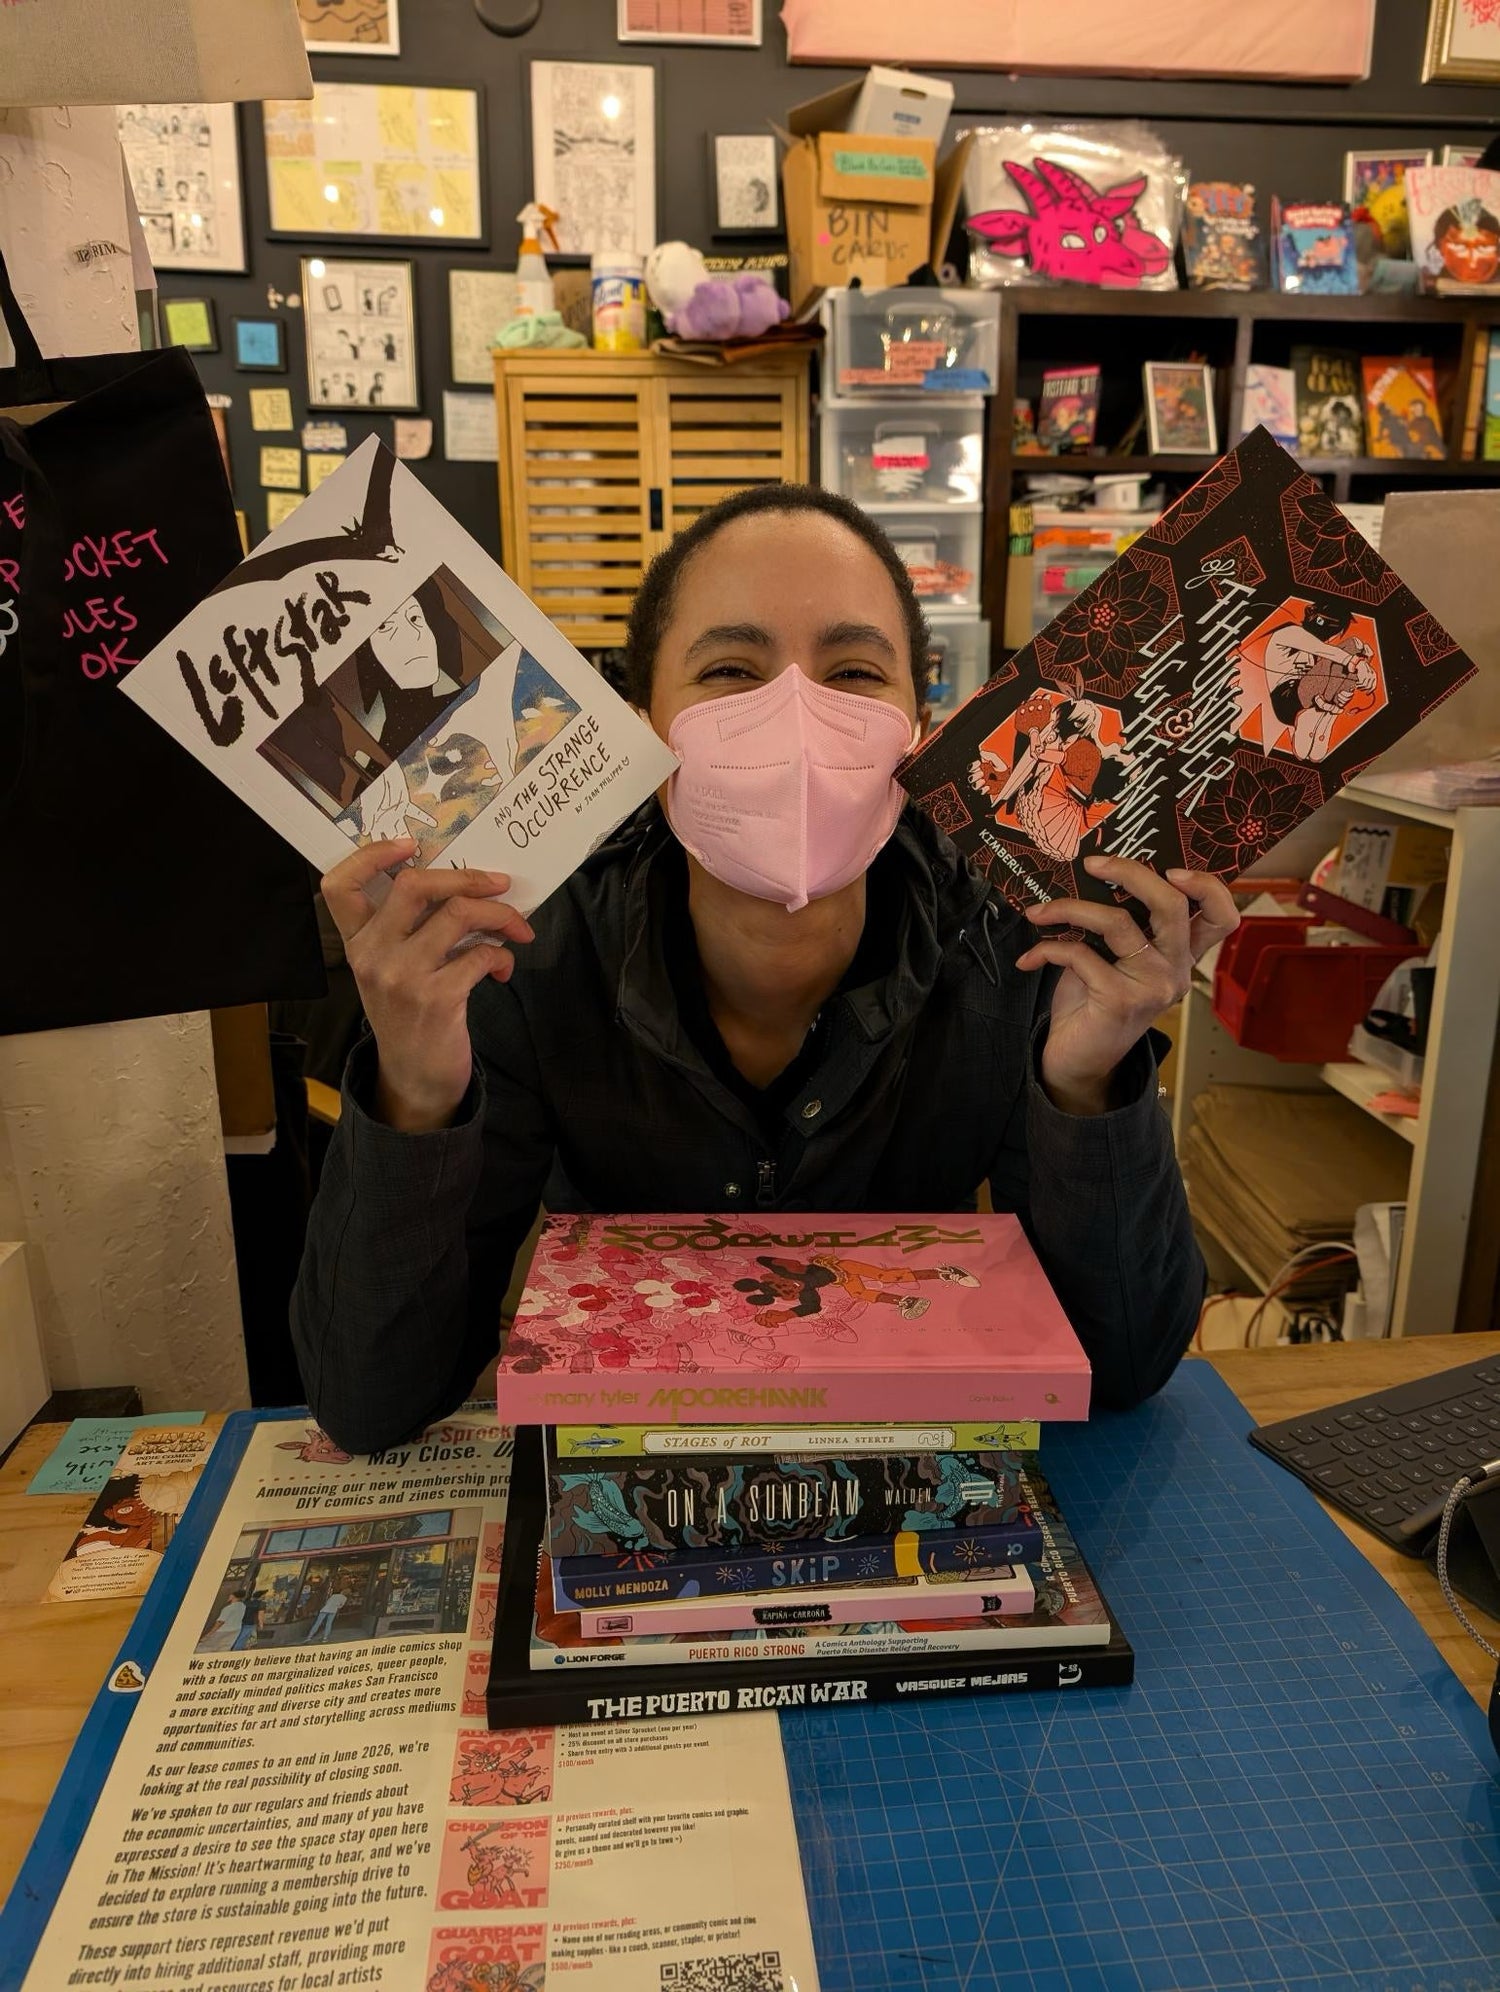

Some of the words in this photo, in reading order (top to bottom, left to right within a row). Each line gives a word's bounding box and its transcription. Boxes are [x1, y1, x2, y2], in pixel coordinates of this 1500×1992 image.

[81, 638, 140, 680] OK
[1175, 578, 1257, 818] THUNDER
[1164, 708, 1194, 738] &
[494, 806, 513, 830] AND
[512, 780, 539, 811] THE
[538, 715, 600, 791] STRANGE
[507, 741, 611, 849] OCCURRENCE
[574, 804, 584, 815] BY
[598, 764, 624, 791] PHILIPPE
[978, 828, 1025, 877] KIMBERLY
[1023, 874, 1052, 904] WANG
[544, 1390, 594, 1408] mary
[600, 1390, 641, 1409] tyler
[662, 1435, 718, 1449] STAGES
[723, 1435, 735, 1449] of
[741, 1435, 771, 1447] ROT
[808, 1436, 849, 1445] LINNEA
[854, 1435, 895, 1444] STERTE
[368, 1449, 411, 1468] May
[418, 1444, 482, 1463] Close.
[256, 1484, 338, 1498] Announcing
[342, 1483, 365, 1493] our
[369, 1481, 398, 1491] new
[402, 1475, 485, 1491] membership
[884, 1487, 931, 1506] WALDEN
[296, 1497, 321, 1509] DIY
[324, 1495, 374, 1508] comics
[379, 1493, 404, 1504] and
[408, 1490, 445, 1502] zines
[667, 1488, 695, 1528] ON
[716, 1487, 728, 1524] A
[749, 1479, 860, 1523] SUNBEAM
[1049, 1550, 1065, 1569] RICO
[574, 1584, 611, 1600] MOLLY
[616, 1579, 669, 1596] MENDOZA
[1058, 1571, 1081, 1603] PUERTO
[689, 1647, 730, 1660] PUERTO
[733, 1646, 759, 1658] RICO
[763, 1644, 805, 1657] STRONG
[821, 1640, 848, 1648] Comics
[848, 1639, 887, 1647] Anthology
[887, 1637, 929, 1646] Supporting
[859, 1646, 889, 1654] Disaster
[889, 1645, 911, 1653] Relief
[927, 1643, 960, 1651] Recovery
[189, 1660, 204, 1670] We
[207, 1657, 251, 1670] strongly
[254, 1655, 291, 1666] believe
[294, 1652, 316, 1664] that
[318, 1650, 353, 1662] having
[355, 1648, 368, 1658] an
[371, 1644, 396, 1656] indie
[399, 1642, 435, 1653] comics
[438, 1640, 462, 1652] shop
[566, 1655, 589, 1663] LION
[590, 1653, 626, 1662] FORGE
[182, 1674, 206, 1686] with
[208, 1676, 216, 1685] a
[218, 1673, 248, 1684] focus
[250, 1673, 264, 1682] on
[267, 1665, 334, 1681] marginalized
[338, 1663, 373, 1675] voices,
[377, 1659, 407, 1672] queer
[409, 1656, 446, 1669] people,
[175, 1690, 197, 1702] and
[198, 1688, 241, 1701] socially
[243, 1685, 283, 1698] minded
[285, 1682, 325, 1695] politics
[328, 1679, 362, 1691] makes
[365, 1676, 385, 1687] San
[388, 1671, 438, 1684] Francisco
[896, 1678, 967, 1693] VASQUEZ
[169, 1709, 177, 1718] a
[179, 1707, 208, 1717] more
[211, 1703, 255, 1716] exciting
[257, 1701, 279, 1713] and
[281, 1699, 320, 1711] diverse
[324, 1696, 345, 1707] city
[347, 1692, 368, 1705] and
[370, 1689, 411, 1702] creates
[414, 1687, 441, 1697] more
[587, 1695, 643, 1720] THE
[645, 1689, 731, 1716] PUERTO
[736, 1684, 806, 1709] RICAN
[811, 1679, 868, 1704] WAR
[163, 1721, 238, 1736] opportunities
[241, 1719, 258, 1730] for
[259, 1717, 277, 1729] art
[280, 1715, 301, 1727] and
[303, 1710, 366, 1725] storytelling
[369, 1706, 405, 1718] across
[408, 1702, 456, 1713] mediums
[156, 1740, 179, 1753] and
[180, 1737, 254, 1751] communities.
[459, 1734, 553, 1754] GOAT
[523, 1830, 548, 1838] THE
[440, 1887, 547, 1910] GOAT
[436, 1925, 543, 1940] GUARDIAN
[439, 1942, 541, 1964] GOAT
